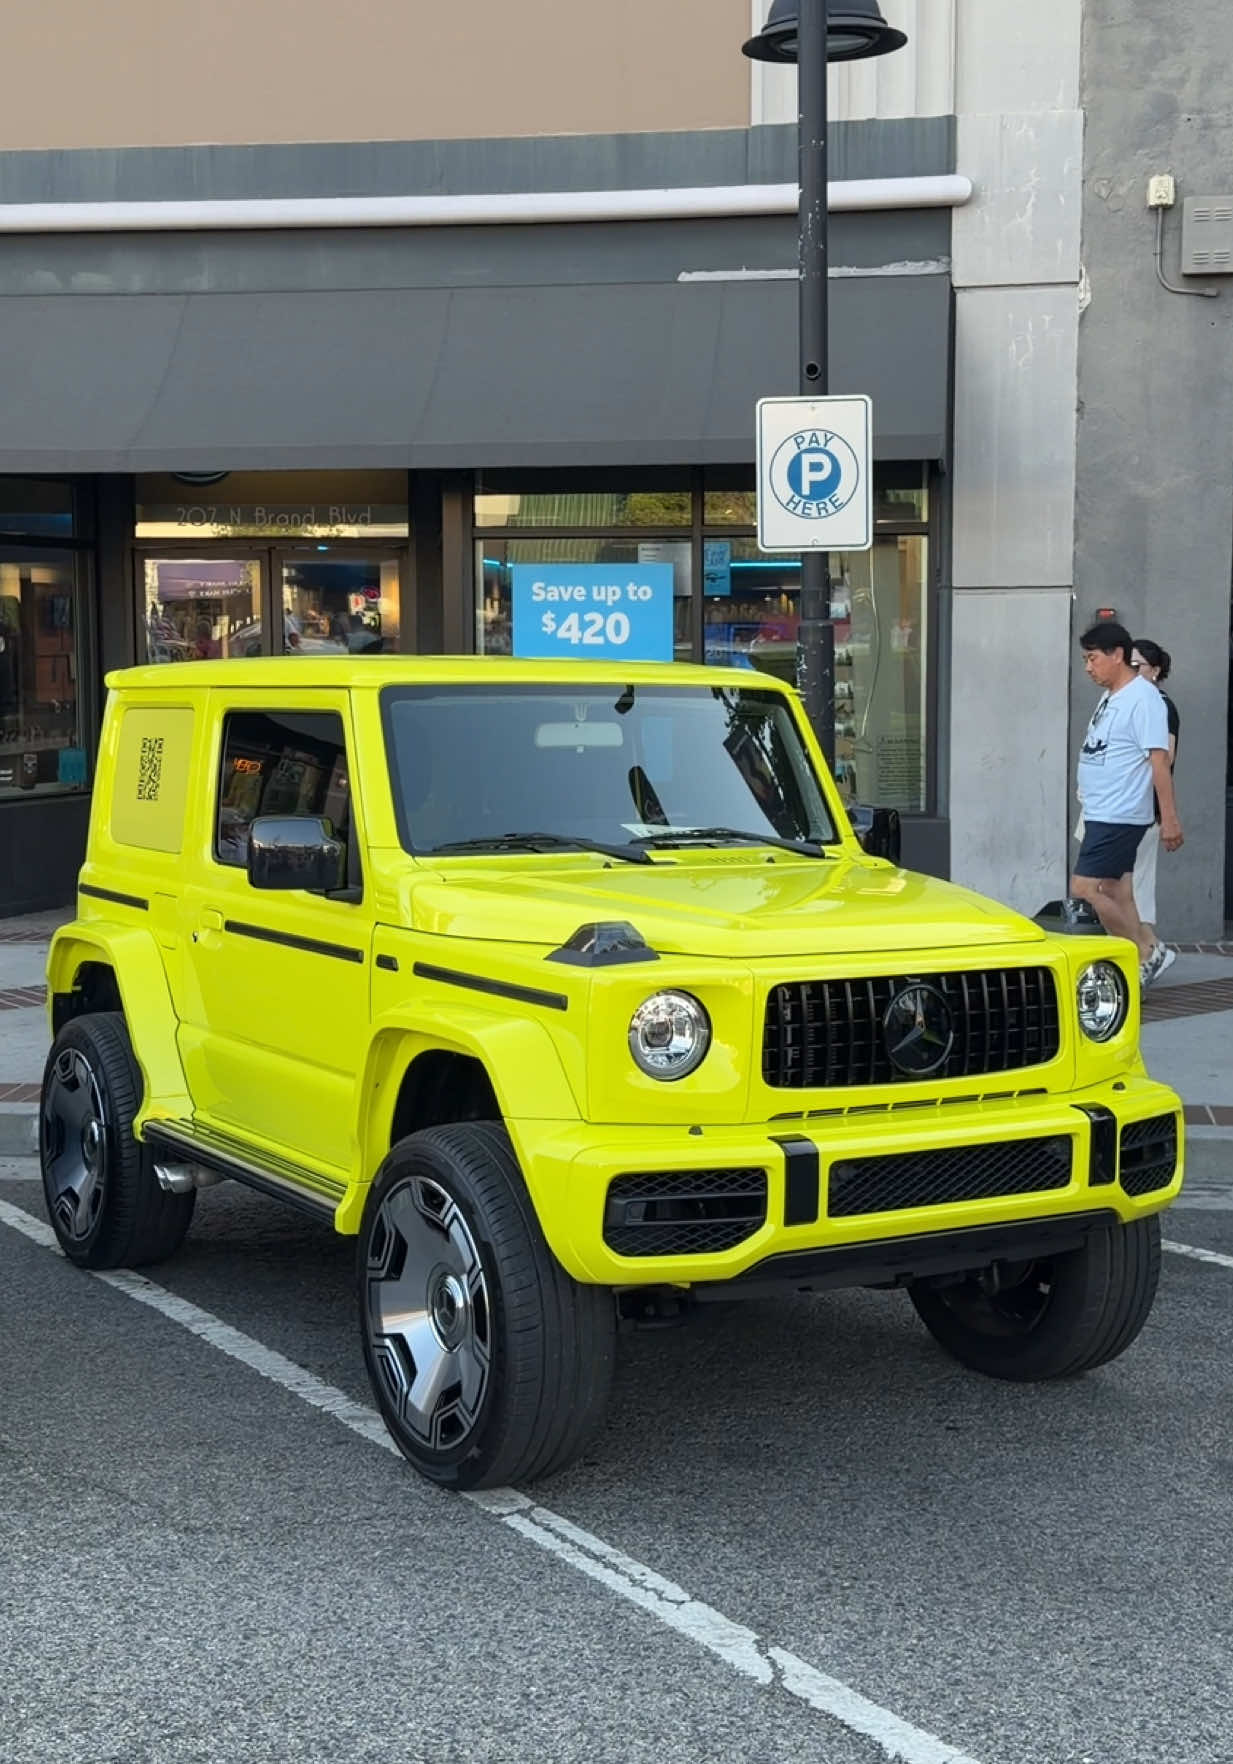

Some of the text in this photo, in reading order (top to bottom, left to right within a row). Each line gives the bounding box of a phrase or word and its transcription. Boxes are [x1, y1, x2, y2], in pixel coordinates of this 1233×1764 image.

[793, 432, 835, 450] PAY
[801, 452, 833, 497] P
[176, 506, 372, 526] 207 N Brand Blvd
[785, 493, 844, 517] HERE
[531, 581, 653, 606] Save up to
[541, 609, 631, 645] $420
